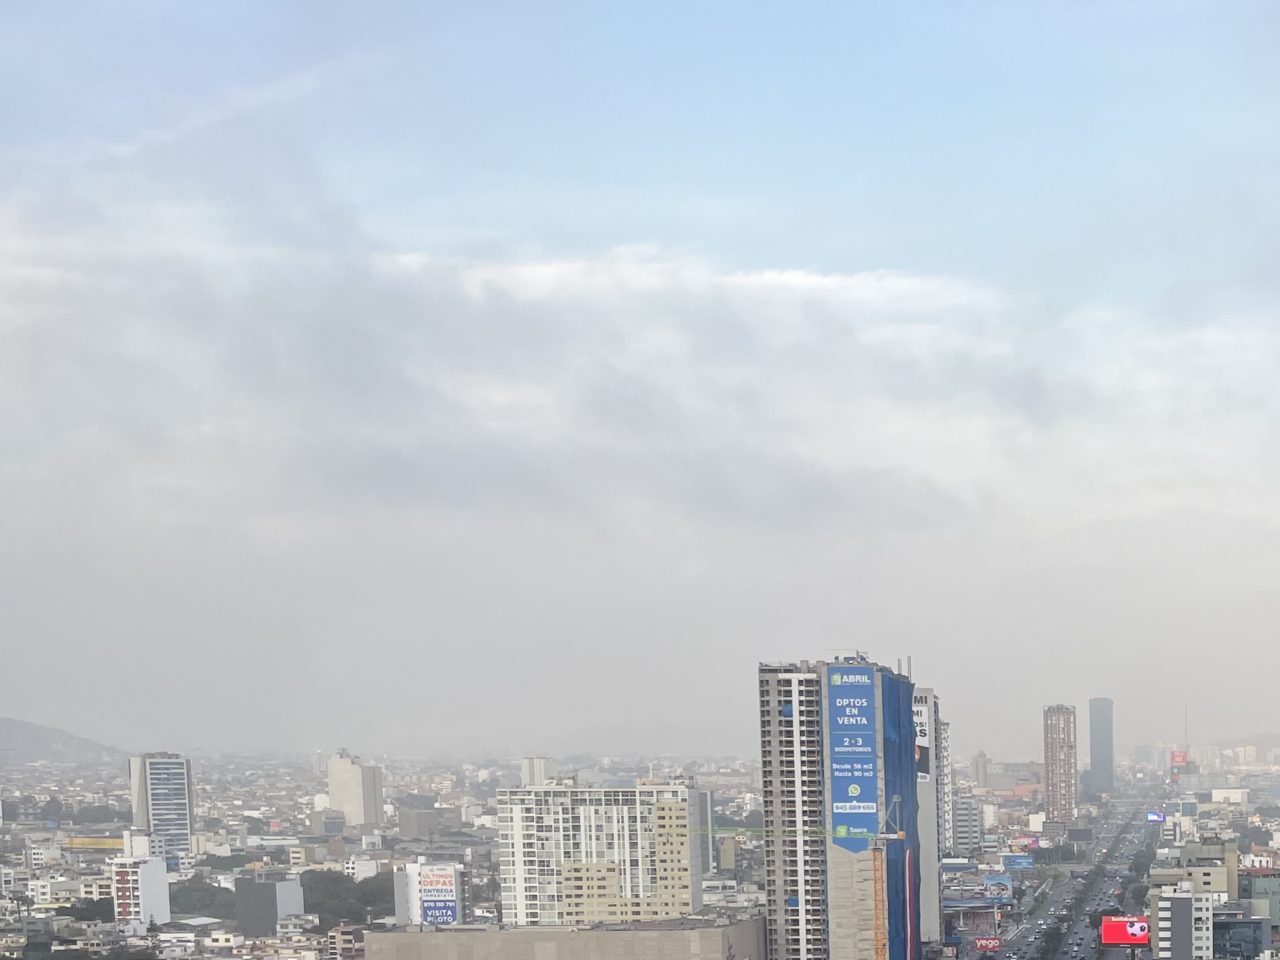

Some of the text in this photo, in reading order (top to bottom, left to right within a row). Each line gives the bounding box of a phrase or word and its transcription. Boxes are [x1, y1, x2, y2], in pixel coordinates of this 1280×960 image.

[842, 675, 871, 683] ABRIL
[836, 698, 868, 707] DPTOS
[846, 707, 858, 716] EN
[837, 716, 868, 725] VENTA
[843, 737, 850, 746] 2
[856, 737, 863, 746] 3
[423, 879, 454, 887] DEPAS
[975, 939, 1000, 949] yego
